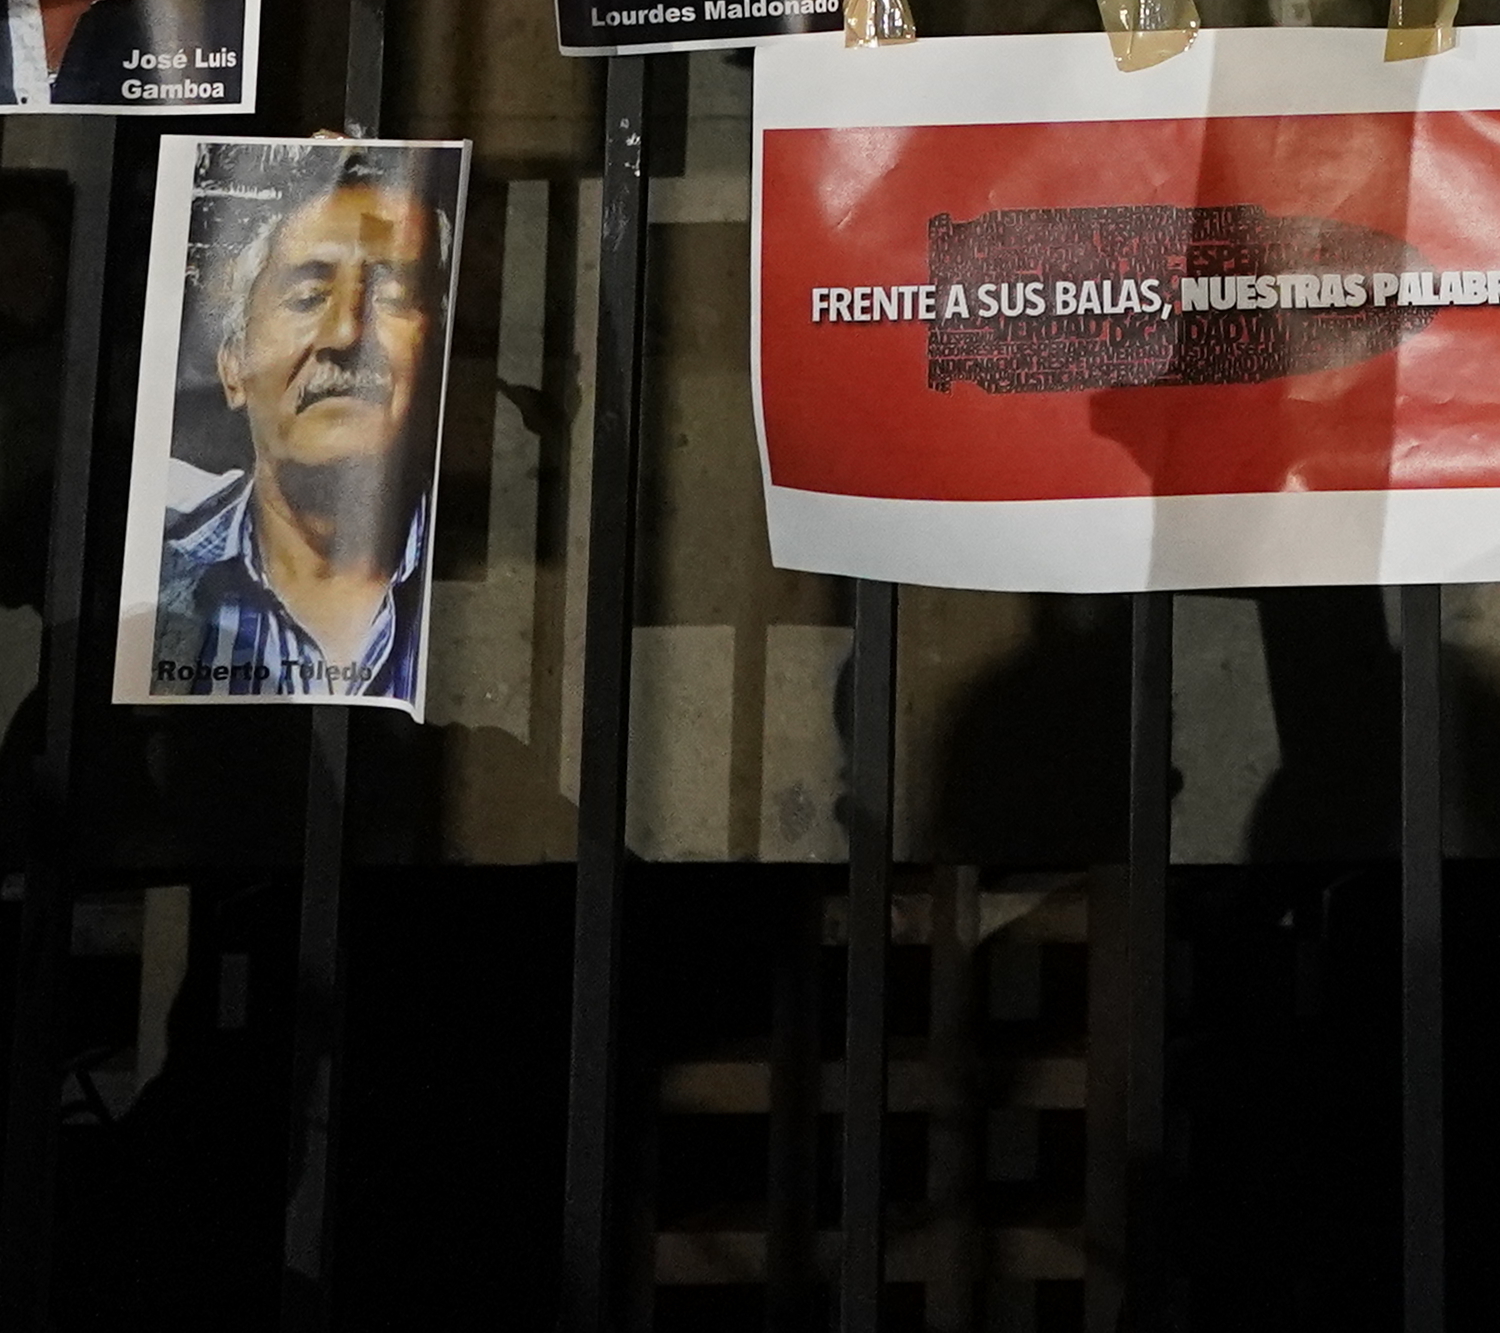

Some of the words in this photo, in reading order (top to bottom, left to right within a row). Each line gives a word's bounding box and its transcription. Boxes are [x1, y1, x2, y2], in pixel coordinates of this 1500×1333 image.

[591, 3, 697, 27] Lourdes
[122, 49, 189, 71] José
[194, 47, 238, 69] Luis
[121, 78, 225, 100] Gamboa
[812, 284, 936, 323] FRENTE
[945, 284, 970, 319] A
[978, 282, 1046, 319] SUS
[1056, 278, 1173, 321] BALAS,
[1181, 273, 1368, 313] NUESTRAS
[157, 660, 271, 682] Roberto
[281, 659, 374, 683] Toledo
